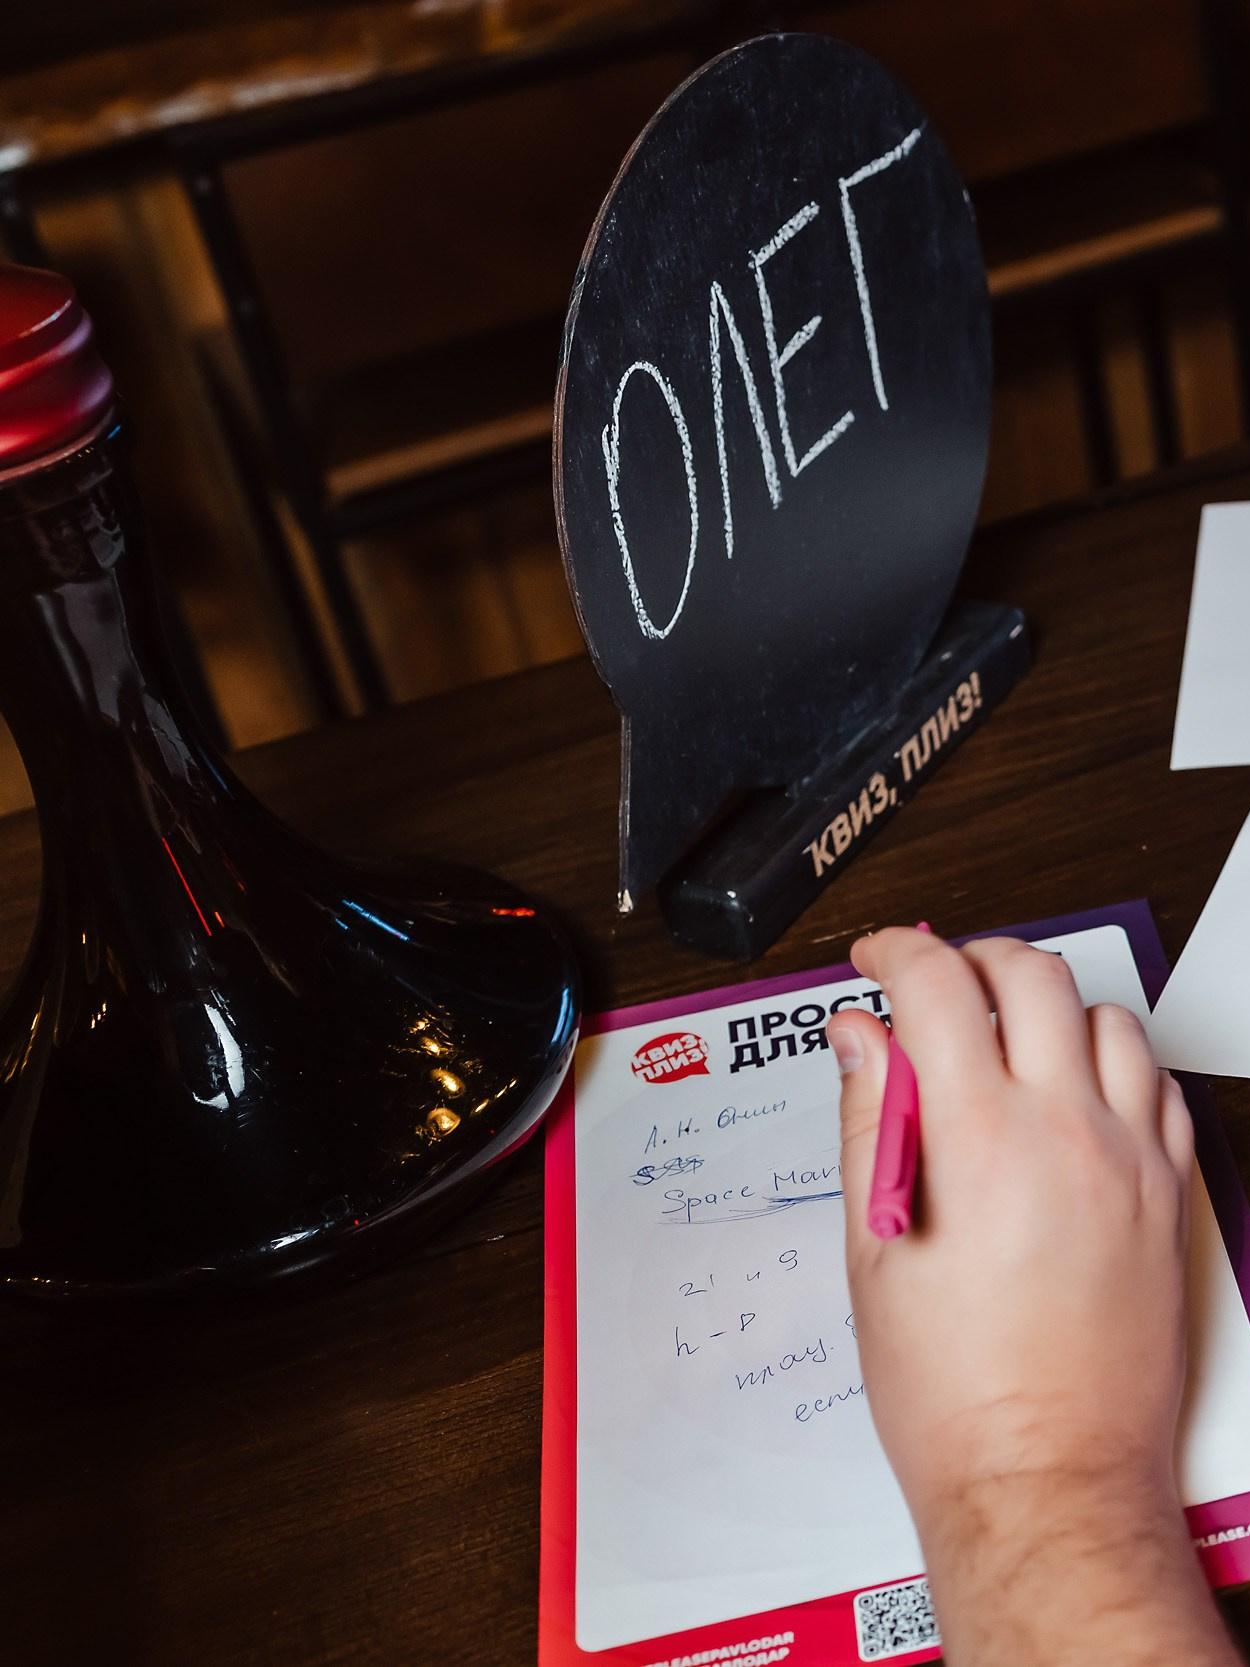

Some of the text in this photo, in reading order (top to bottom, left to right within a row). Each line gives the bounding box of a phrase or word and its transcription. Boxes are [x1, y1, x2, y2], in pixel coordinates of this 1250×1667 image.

[601, 124, 925, 640] ОЛЕГ
[804, 671, 983, 878] КВИЗ, ПЛИЗ!
[729, 1025, 829, 1074] ДЛЯ
[661, 1184, 757, 1223] Space
